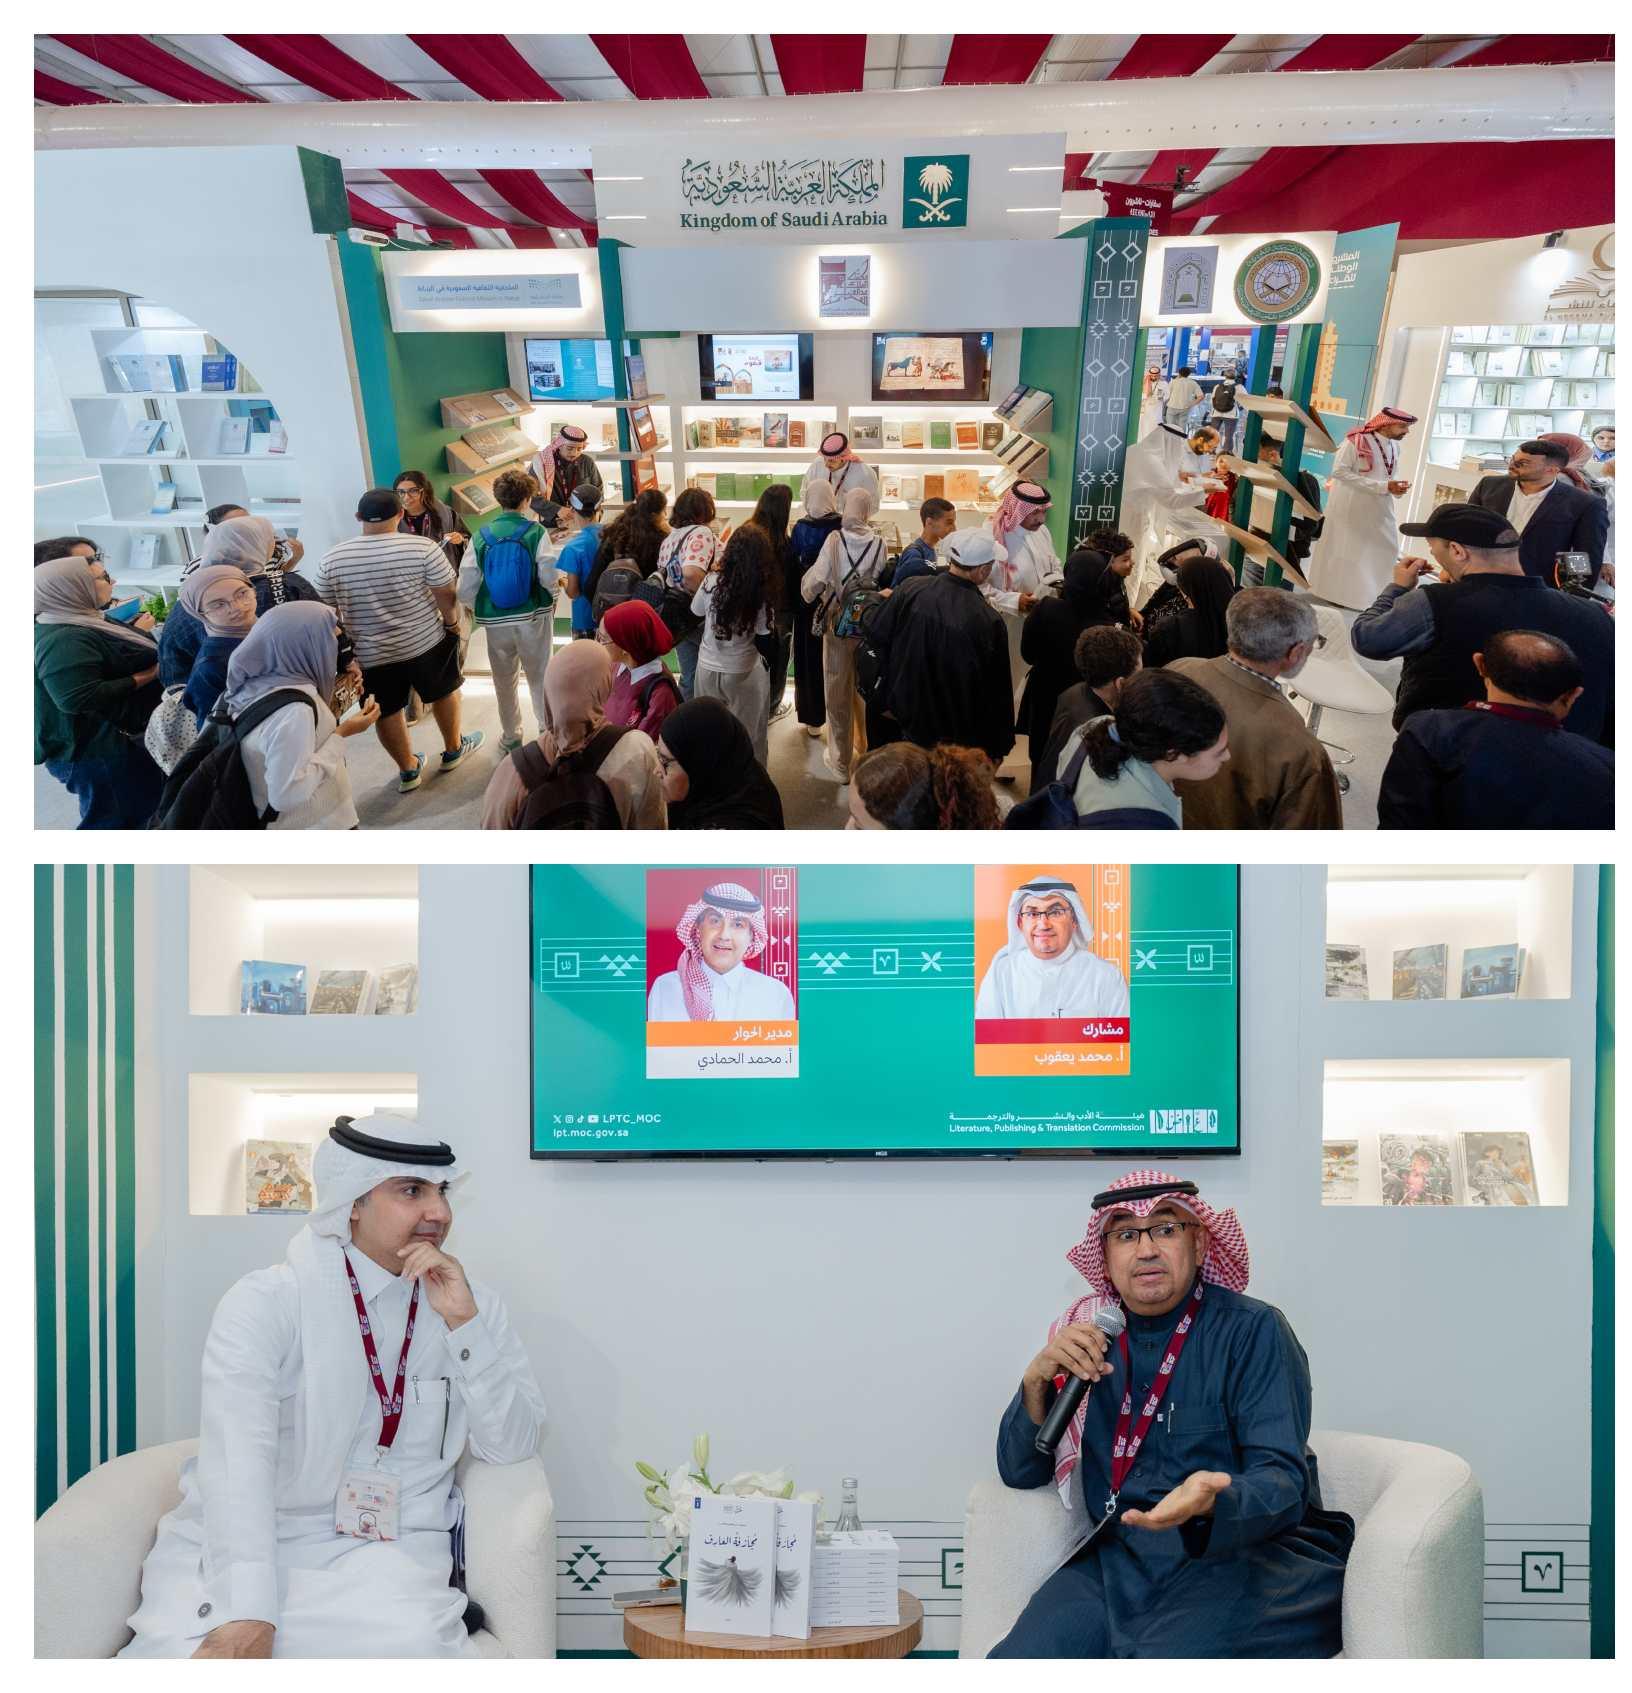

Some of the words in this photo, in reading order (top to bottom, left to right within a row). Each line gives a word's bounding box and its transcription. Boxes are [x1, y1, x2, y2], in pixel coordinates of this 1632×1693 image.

[681, 158, 777, 207] السعودية
[774, 158, 833, 206] العربية
[831, 158, 886, 206] المملكة
[680, 213, 758, 232] Kingdom
[760, 212, 779, 228] of
[781, 211, 829, 228] Saudi
[831, 210, 888, 227] Arabia
[732, 1026, 763, 1041] الحوار
[763, 1027, 793, 1041] مدير
[1082, 1022, 1124, 1037] مشارك
[697, 1051, 744, 1070] الحمادي
[747, 1053, 782, 1066] محمد
[785, 1048, 793, 1064] أ.
[1034, 1052, 1075, 1065] يعقوب
[1077, 1051, 1113, 1064] محمد
[1116, 1046, 1124, 1062] أ.
[603, 1113, 662, 1124] LPTC_MOC
[949, 1112, 1016, 1122] والترجمة
[1016, 1112, 1075, 1123] والنشر
[1075, 1111, 1095, 1122] الأدب
[553, 1128, 629, 1139] lpt.moc.gov.sa
[949, 1124, 993, 1134] Literature,
[994, 1123, 1037, 1134] Publishing
[1037, 1124, 1045, 1132] &
[1046, 1123, 1092, 1132] Translation
[1092, 1123, 1145, 1132] Commission
